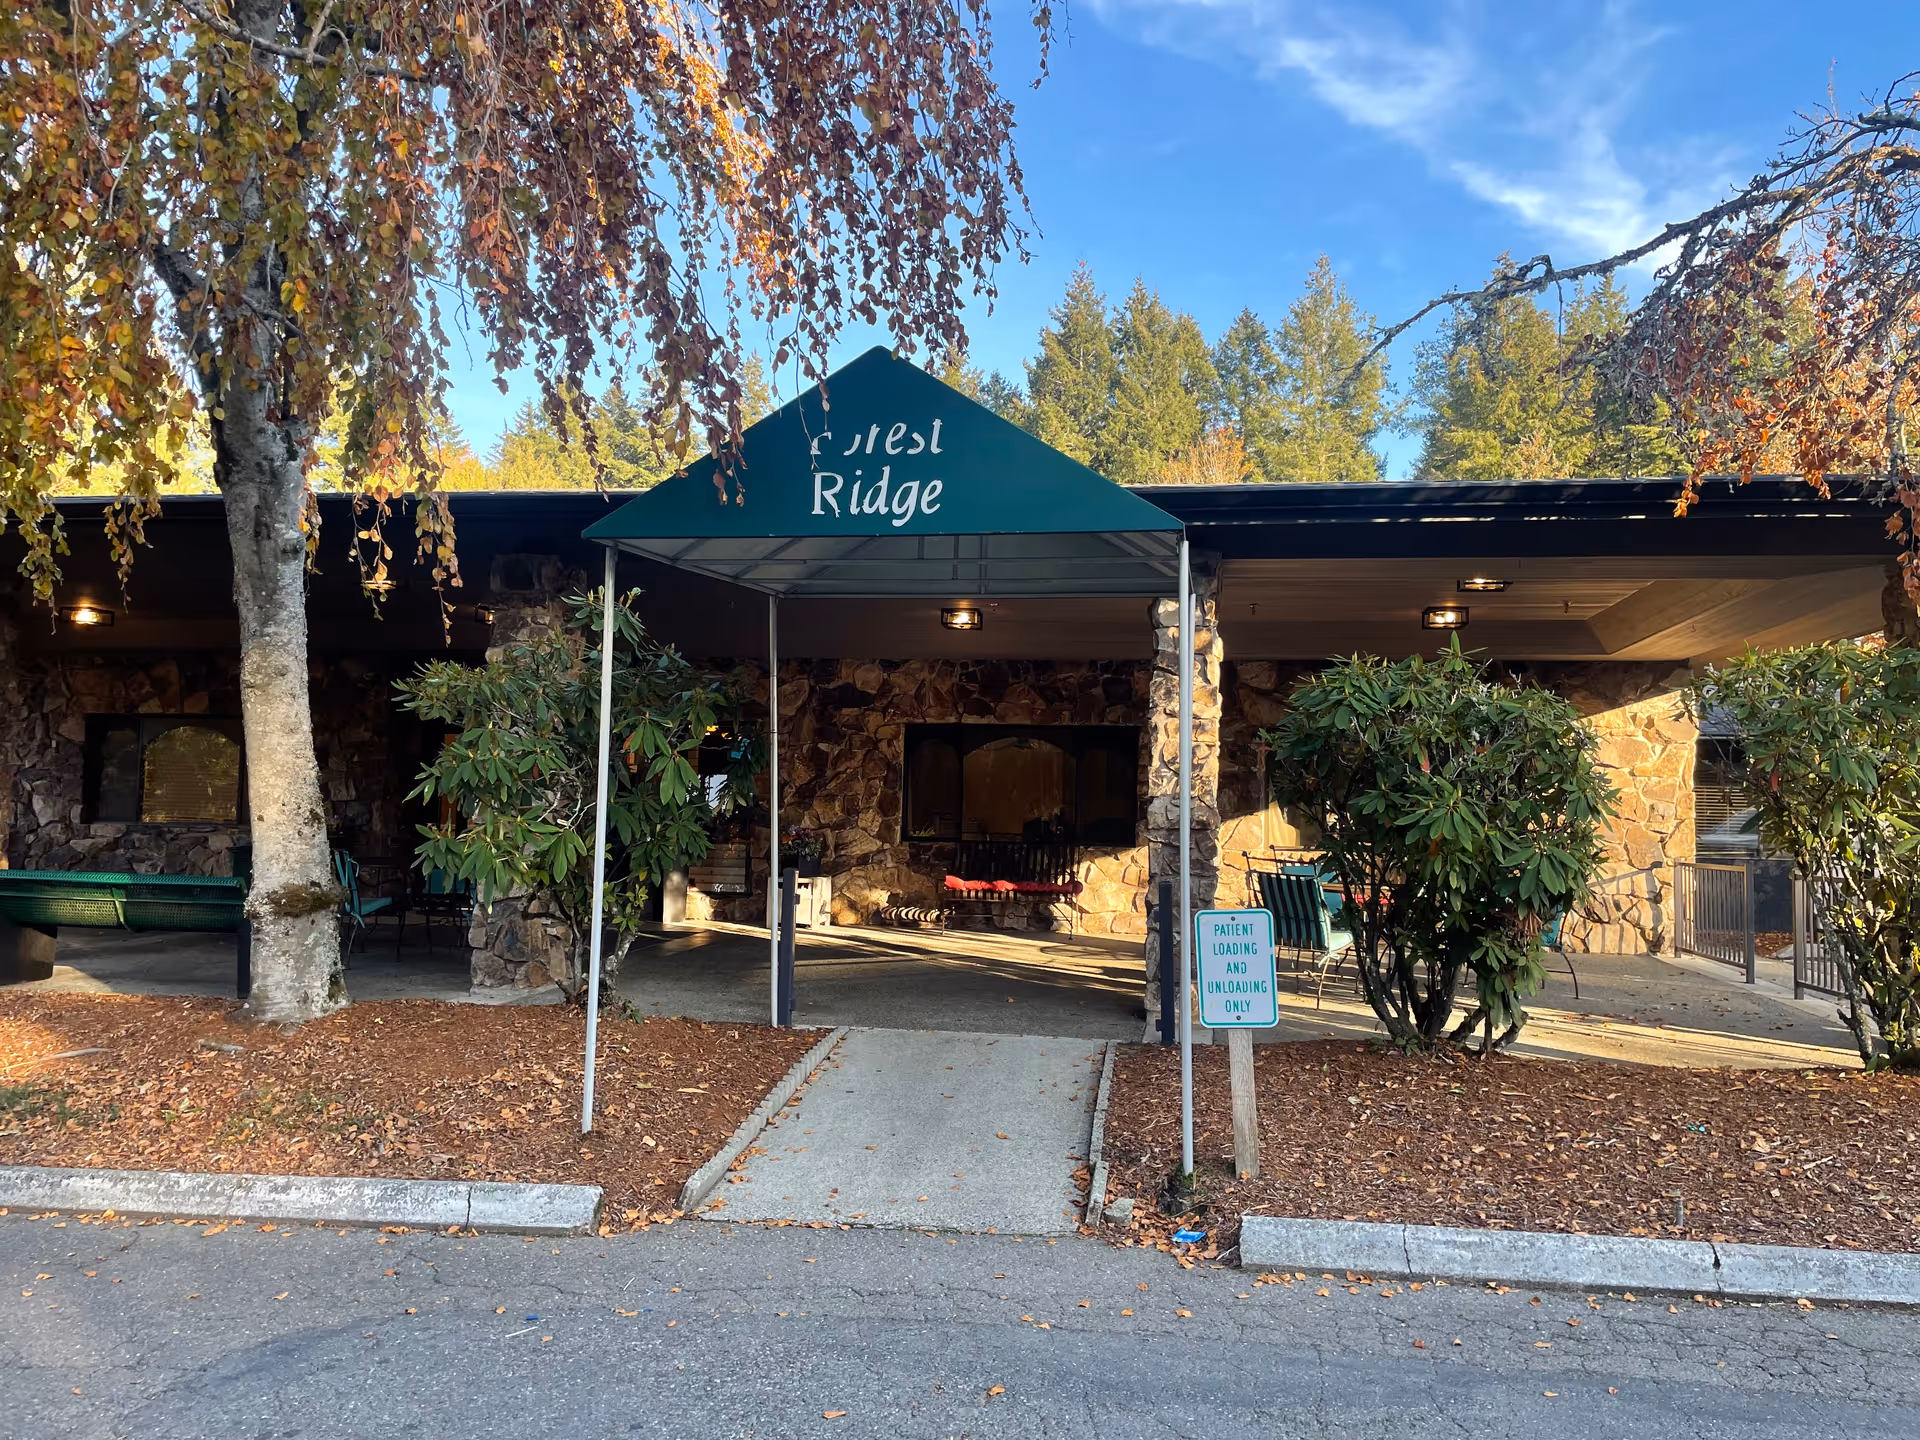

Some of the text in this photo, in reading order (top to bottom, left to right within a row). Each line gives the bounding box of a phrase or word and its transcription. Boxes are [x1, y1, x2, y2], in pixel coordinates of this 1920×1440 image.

[811, 465, 943, 527] Ridge
[1214, 924, 1254, 936] PATIENT
[1213, 943, 1258, 955] LOADING
[1226, 962, 1247, 974] AND
[1207, 980, 1268, 993] UNLOADING
[1225, 1000, 1251, 1012] ONLY
